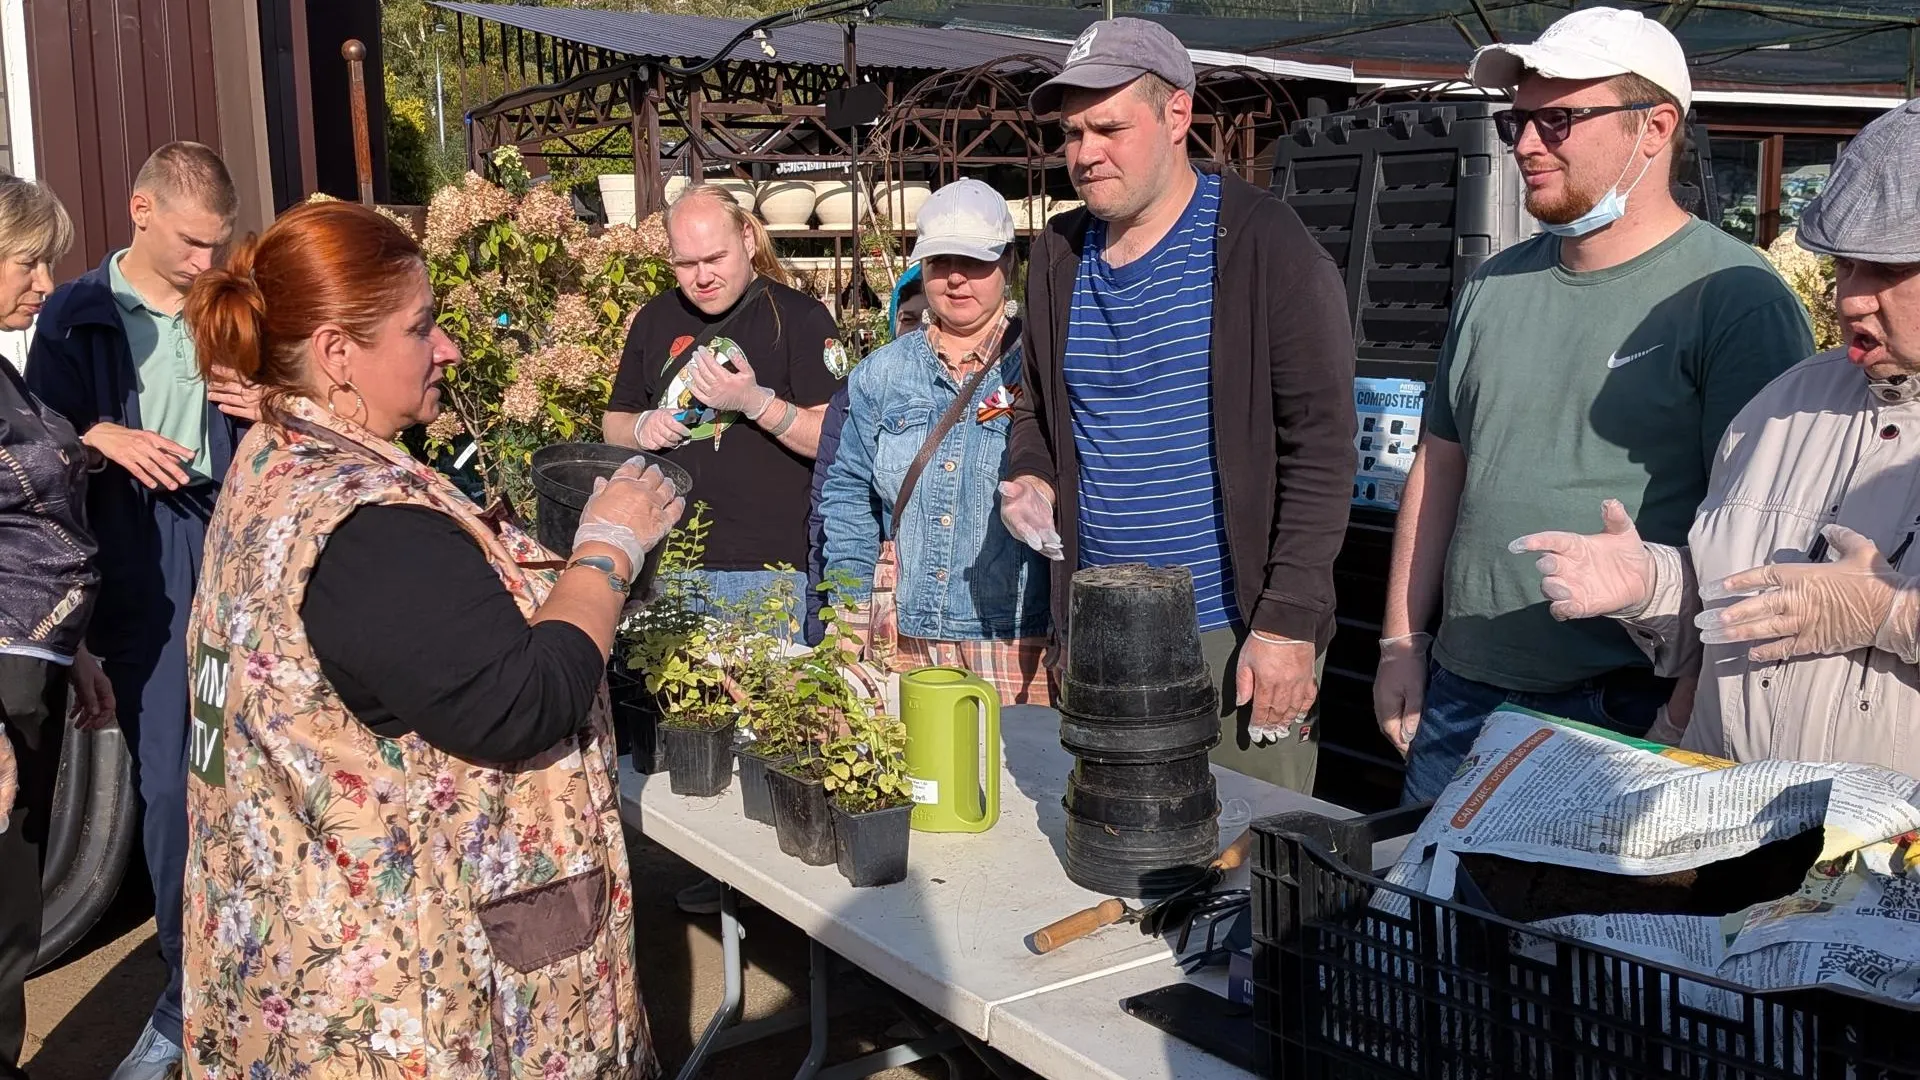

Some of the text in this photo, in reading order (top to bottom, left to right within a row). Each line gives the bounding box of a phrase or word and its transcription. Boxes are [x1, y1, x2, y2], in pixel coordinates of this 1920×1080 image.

[1357, 391, 1420, 409] COMPOSTER
[1463, 765, 1484, 787] НОРД
[1456, 806, 1474, 824] САД
[1469, 782, 1492, 808] ЧУДЕС
[1490, 755, 1517, 783] ОГОРОД
